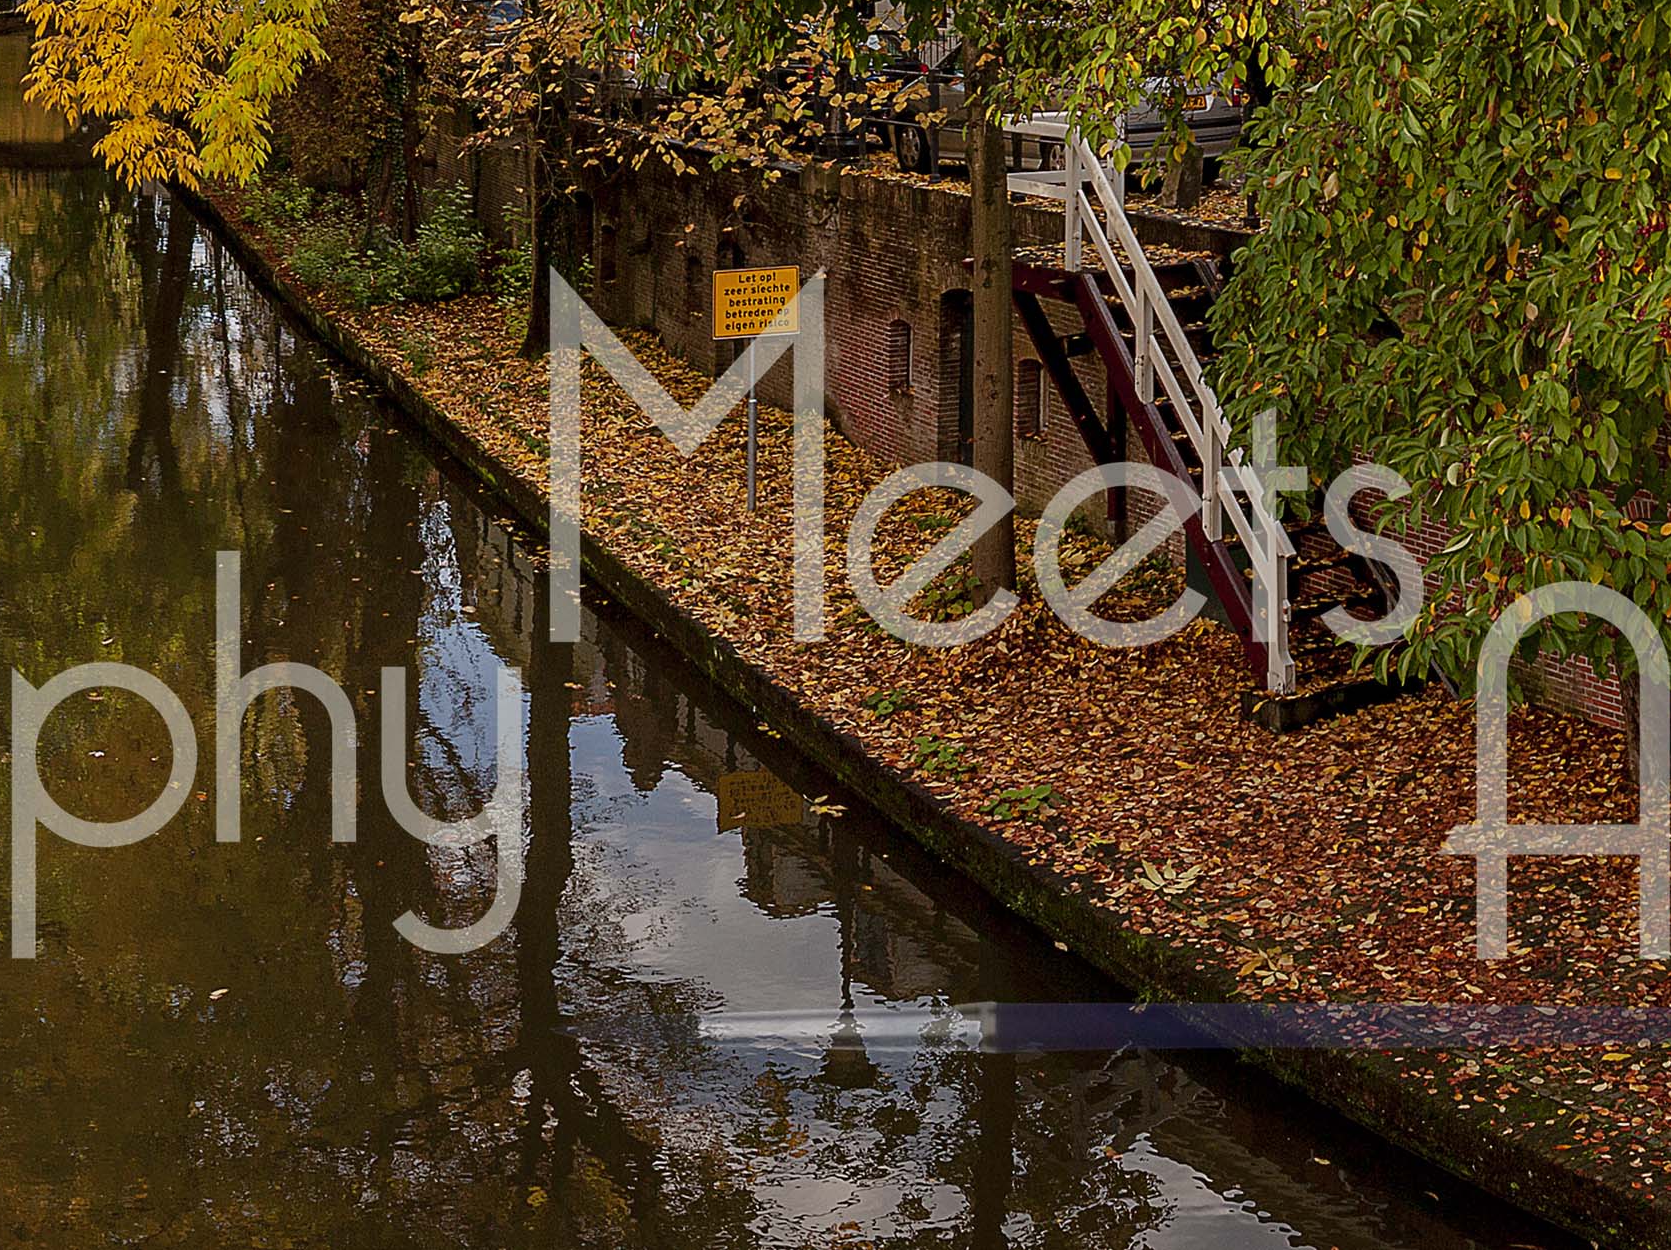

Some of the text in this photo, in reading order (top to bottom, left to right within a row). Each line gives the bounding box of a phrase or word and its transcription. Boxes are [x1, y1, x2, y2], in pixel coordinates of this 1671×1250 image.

[738, 271, 776, 284] Let op!
[724, 283, 790, 296] zeer slechte
[729, 295, 786, 307] bestrating
[725, 308, 789, 319] betreden op
[725, 319, 789, 332] eigen risico
